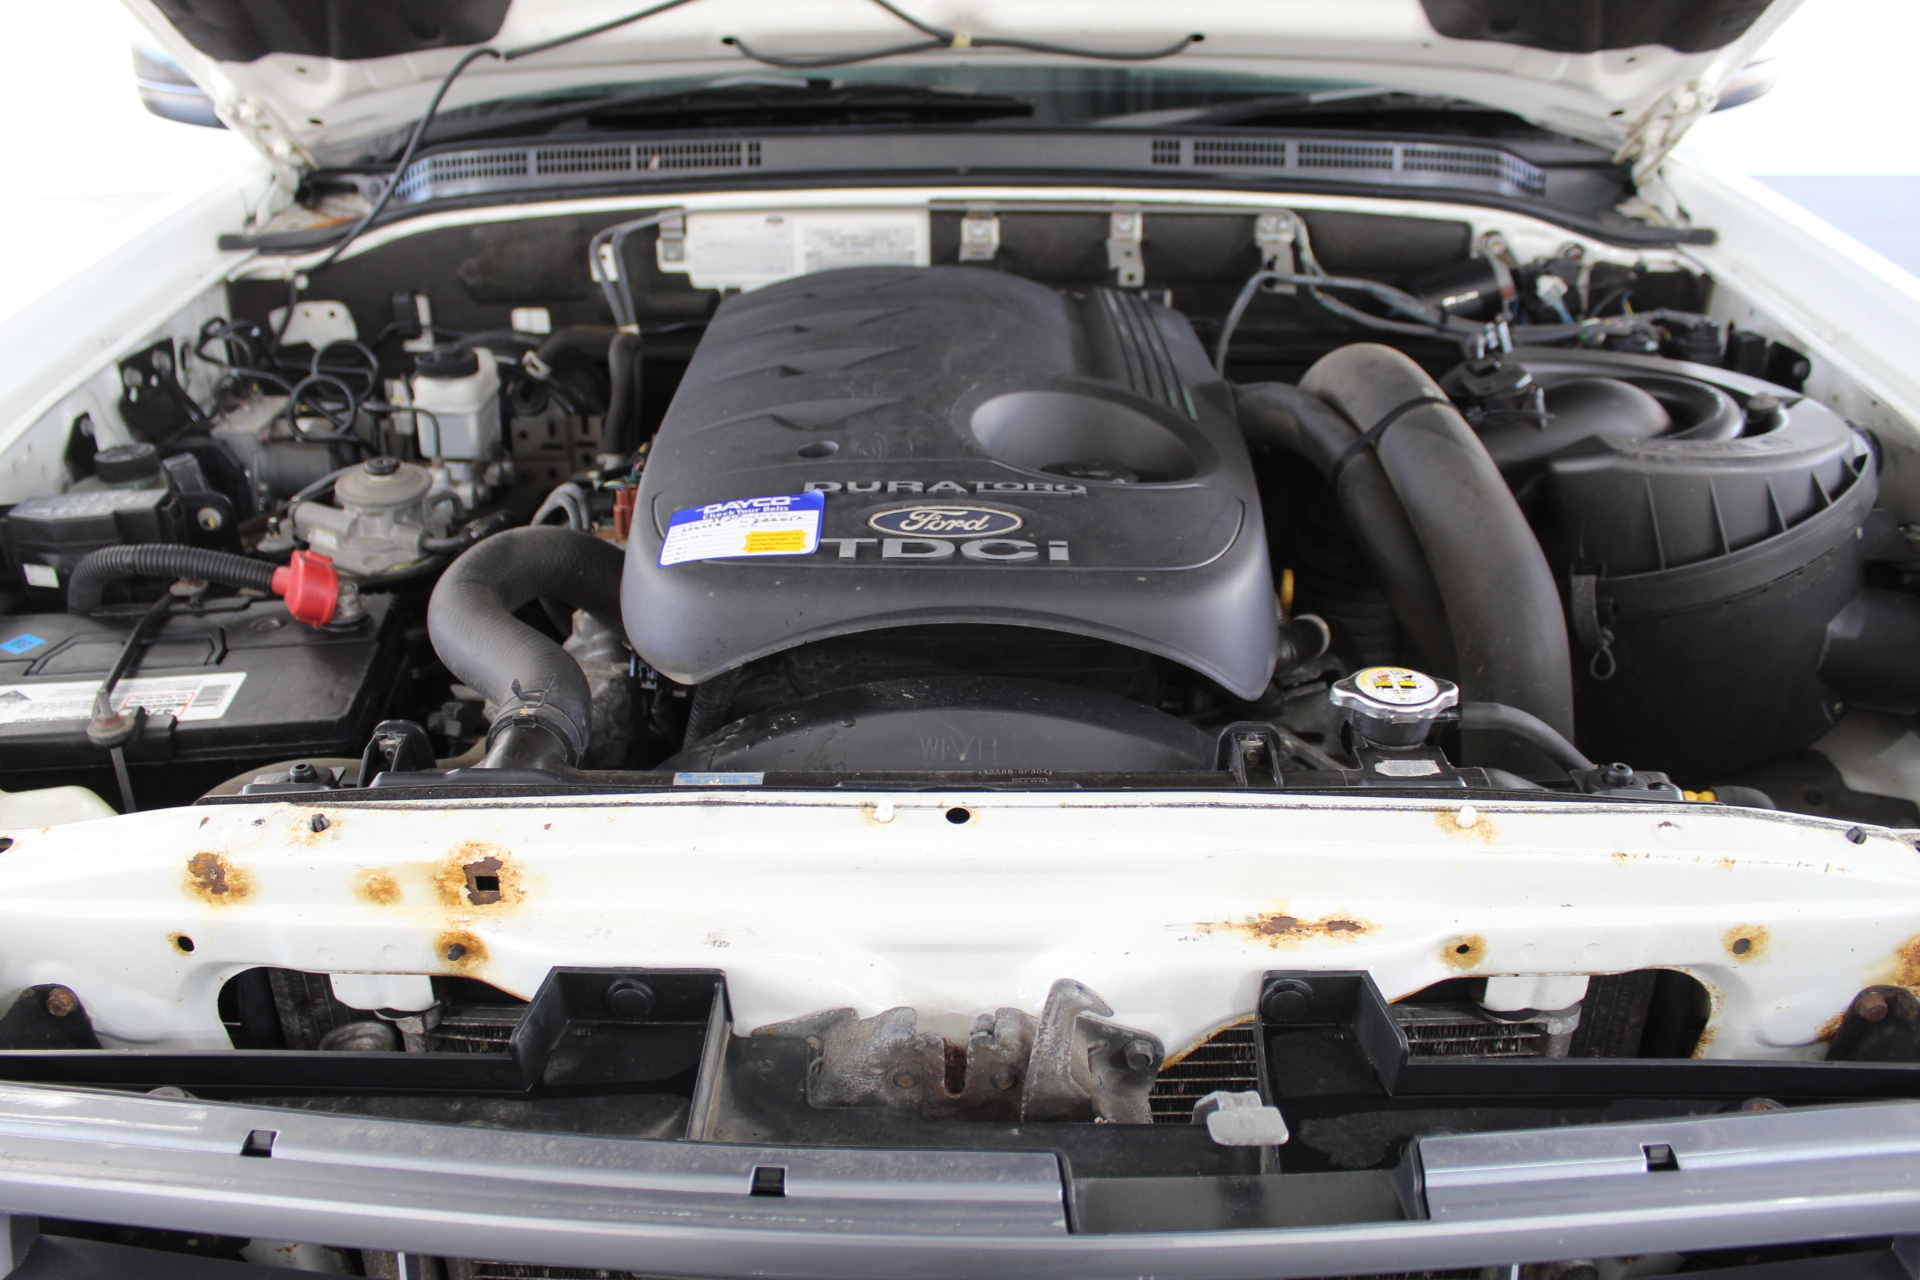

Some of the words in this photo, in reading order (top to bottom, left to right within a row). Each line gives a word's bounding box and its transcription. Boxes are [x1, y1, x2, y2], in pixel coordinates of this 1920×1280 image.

[804, 480, 1088, 496] DURATORQ
[702, 508, 734, 520] Check
[736, 506, 761, 515] Your
[703, 496, 791, 514] DAYCO
[899, 508, 991, 532] Ford
